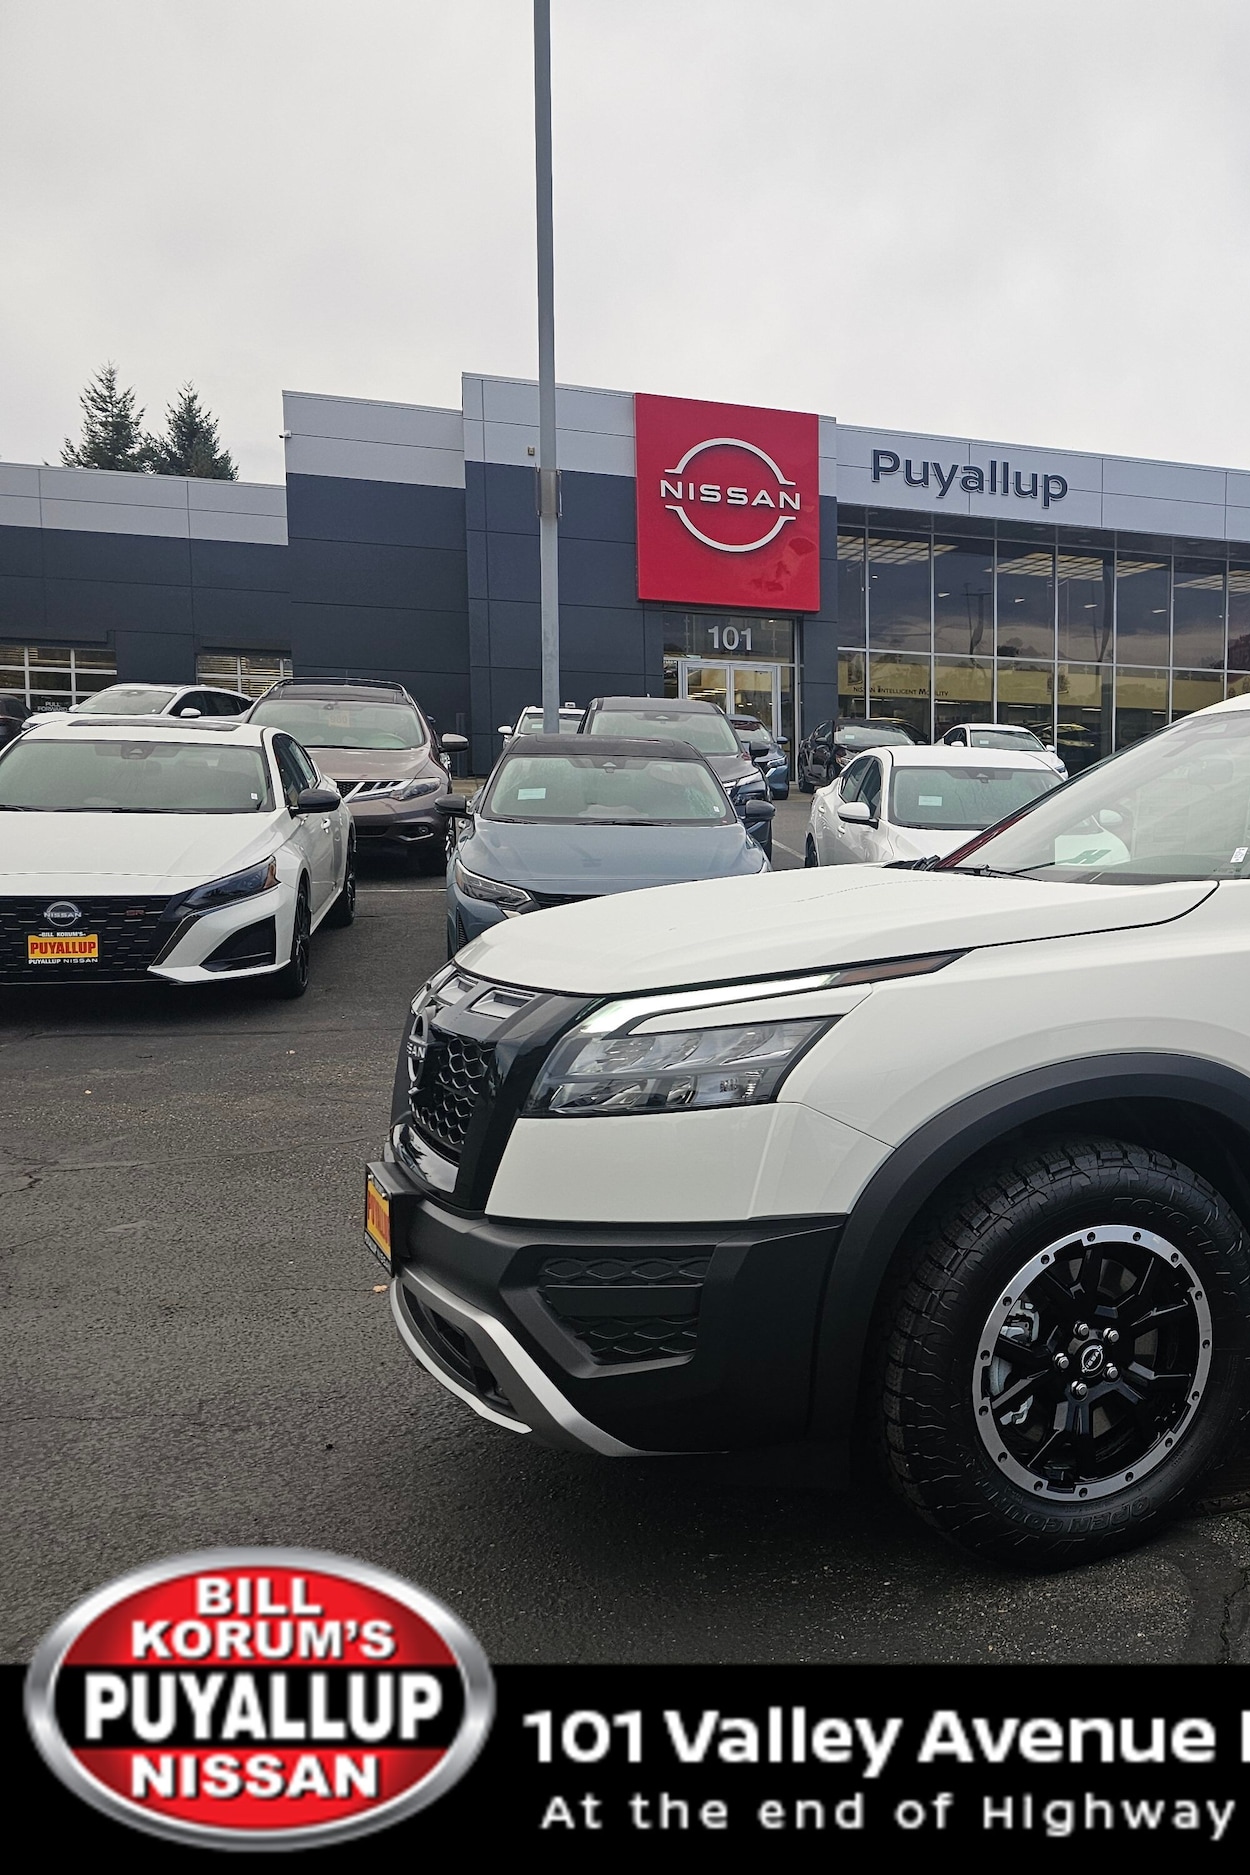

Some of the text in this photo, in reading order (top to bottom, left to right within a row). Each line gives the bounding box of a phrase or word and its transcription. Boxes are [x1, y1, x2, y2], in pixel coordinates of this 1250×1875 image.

[872, 449, 1068, 508] Puyallup
[660, 479, 801, 511] NISSAN
[708, 625, 752, 651] 101
[30, 941, 97, 955] PUYALLUP
